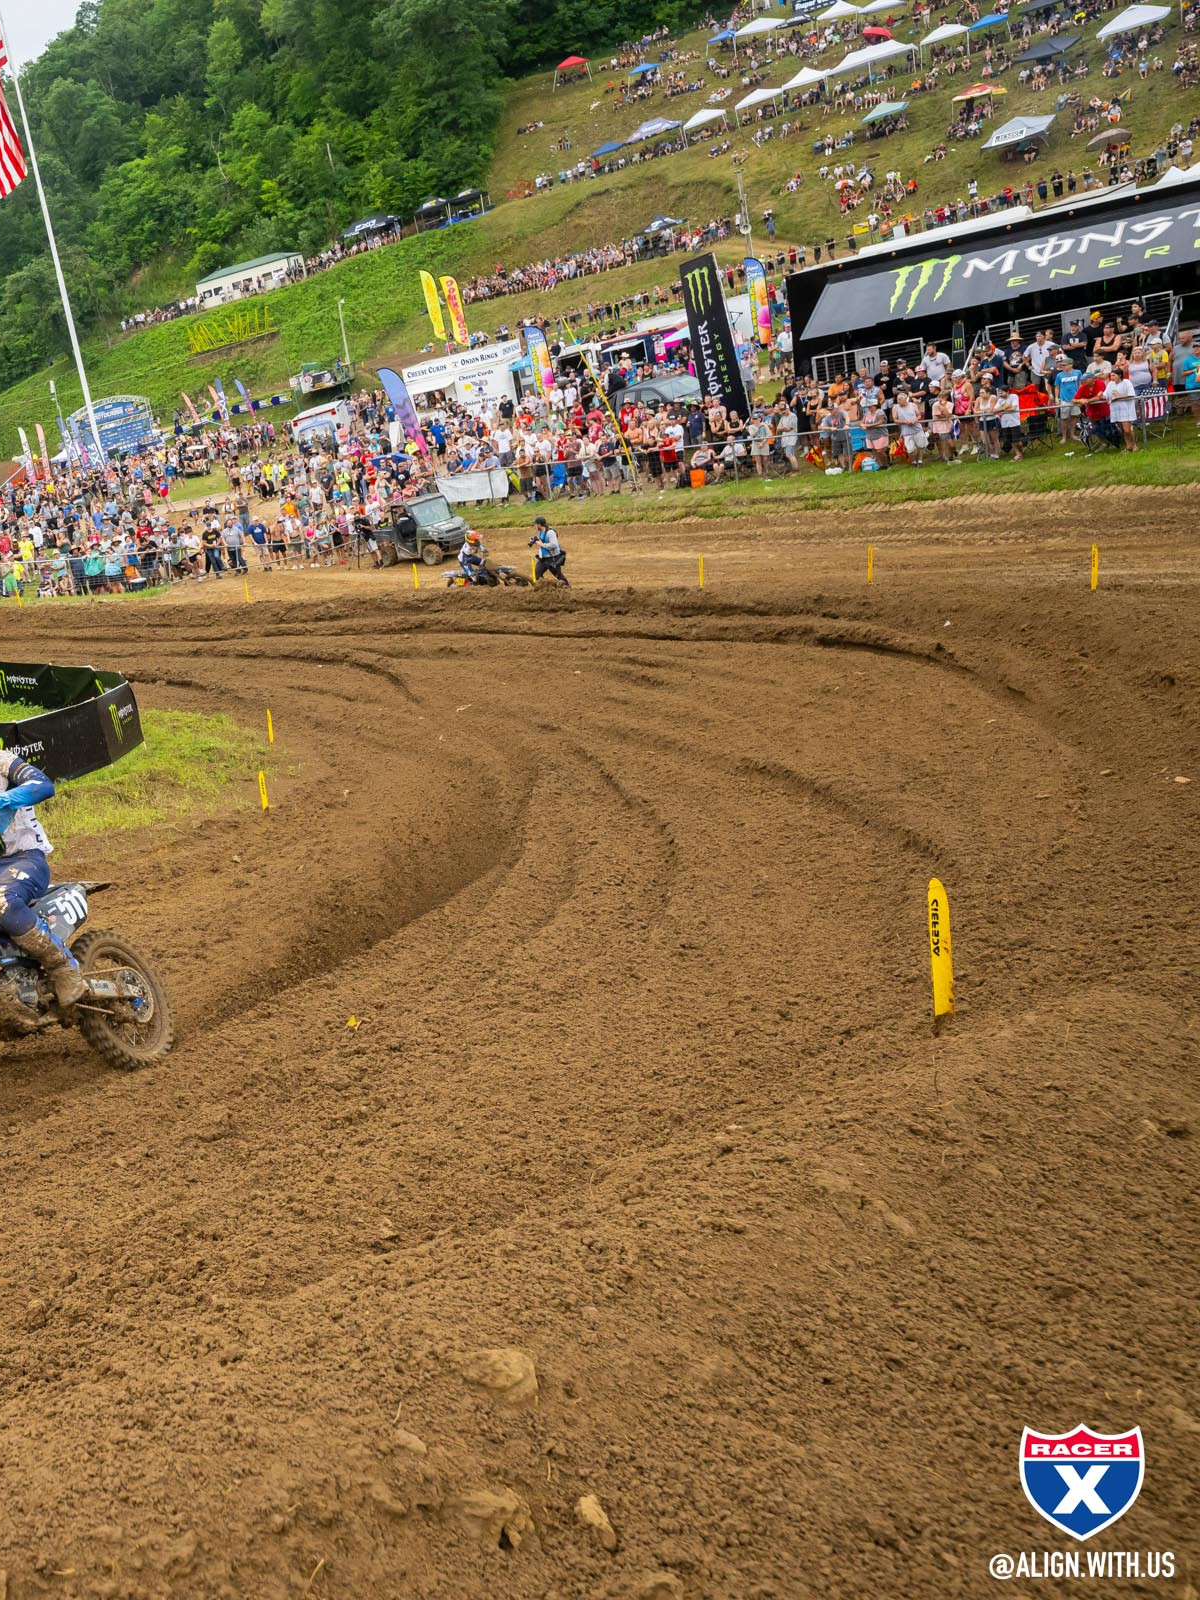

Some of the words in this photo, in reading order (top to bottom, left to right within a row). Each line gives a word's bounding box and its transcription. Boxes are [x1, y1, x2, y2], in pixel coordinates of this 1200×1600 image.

[961, 209, 1200, 278] MONST
[1006, 238, 1200, 287] ENER
[428, 365, 447, 373] CURDS
[460, 357, 479, 366] ONION
[480, 352, 498, 360] RINGS
[698, 320, 724, 398] ONSTER
[713, 333, 732, 393] ENERGY
[6, 675, 39, 685] MONSTER
[55, 889, 88, 924] 511
[931, 898, 940, 957] ACERBIS
